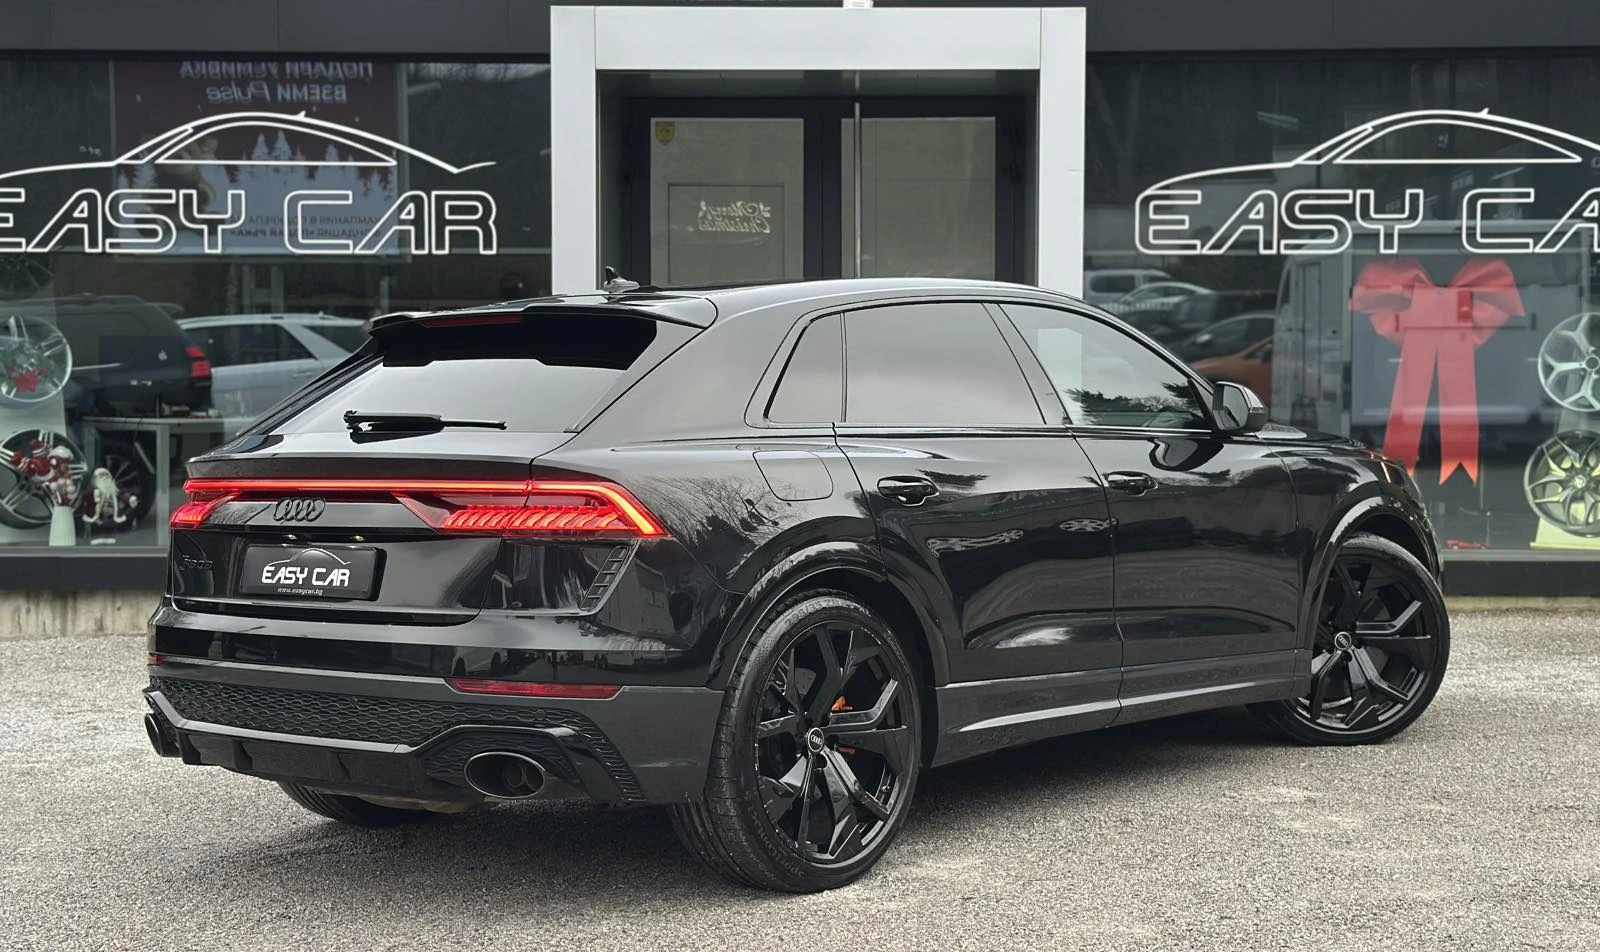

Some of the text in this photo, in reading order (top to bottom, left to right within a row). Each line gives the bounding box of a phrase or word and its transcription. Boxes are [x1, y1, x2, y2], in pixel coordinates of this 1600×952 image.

[284, 189, 497, 255] CAR
[1135, 188, 1424, 255] EASY
[261, 566, 351, 587] EASY CAR
[277, 587, 324, 596] www.easycar.bg
